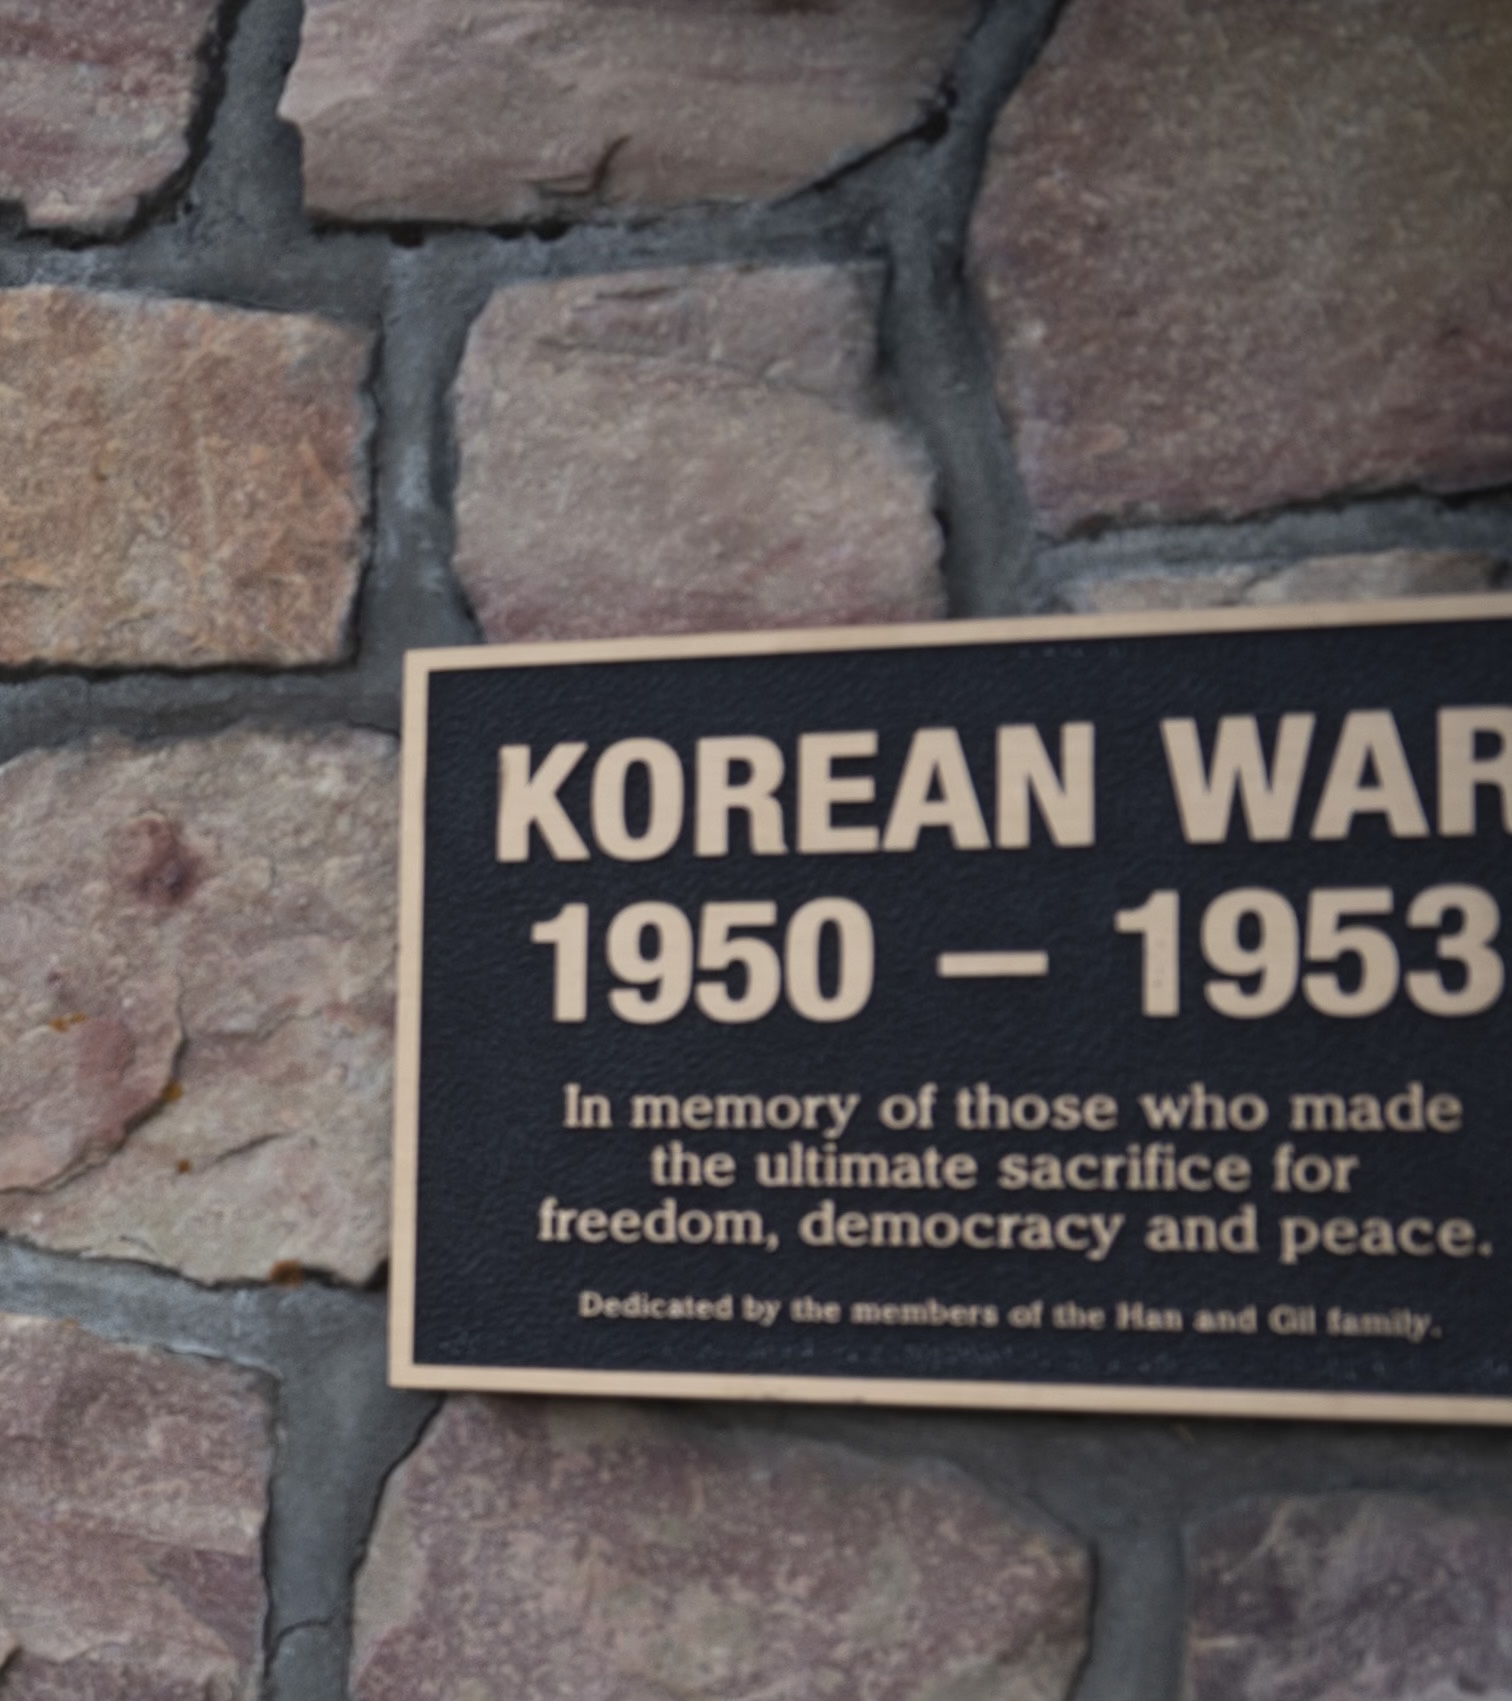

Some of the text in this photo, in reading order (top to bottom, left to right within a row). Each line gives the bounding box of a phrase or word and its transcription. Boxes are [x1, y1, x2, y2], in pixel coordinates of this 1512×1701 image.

[495, 706, 1512, 863] KOREAN WAR
[530, 896, 875, 1024] 1950
[1114, 885, 1504, 1018] 1953
[563, 1082, 1463, 1140] In memory of those who made
[650, 1140, 1358, 1192] the ultimate sacrifice for
[538, 1196, 1492, 1264] freedom, democracy and peace.
[578, 1289, 1443, 1339] Dedicated by the members of the Han and Gil family.
